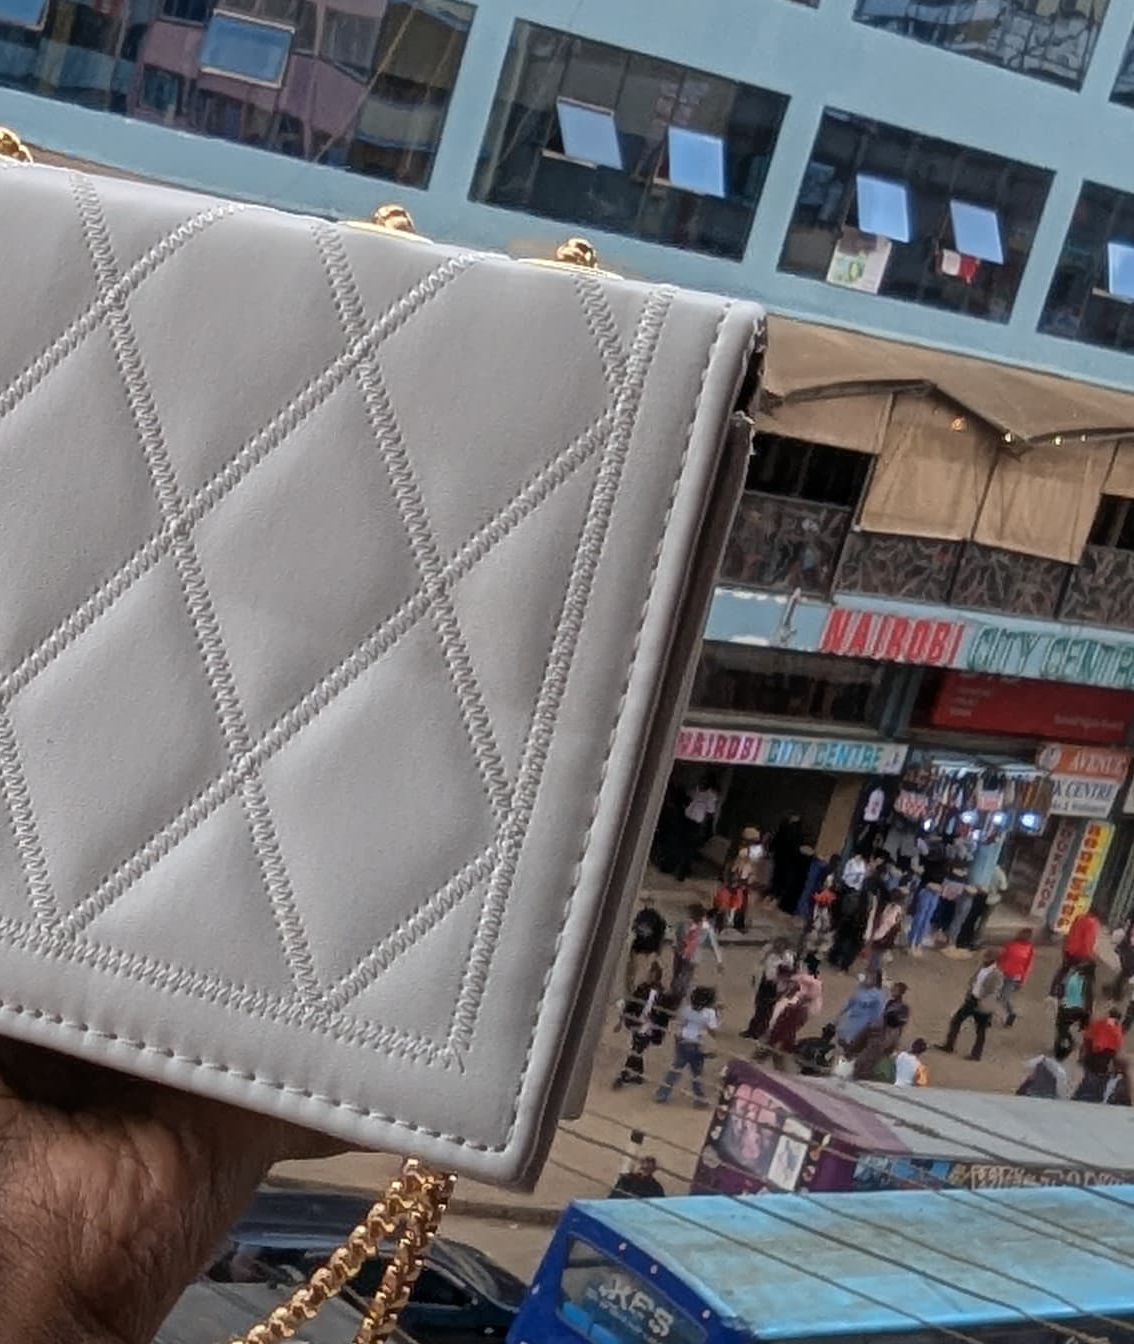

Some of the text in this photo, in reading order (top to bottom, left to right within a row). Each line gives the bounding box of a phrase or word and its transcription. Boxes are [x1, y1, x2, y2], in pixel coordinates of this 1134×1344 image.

[821, 607, 966, 666] NAIROBI
[968, 624, 1042, 675] CITY
[676, 730, 883, 772] NAIROBI CITY CENTRE
